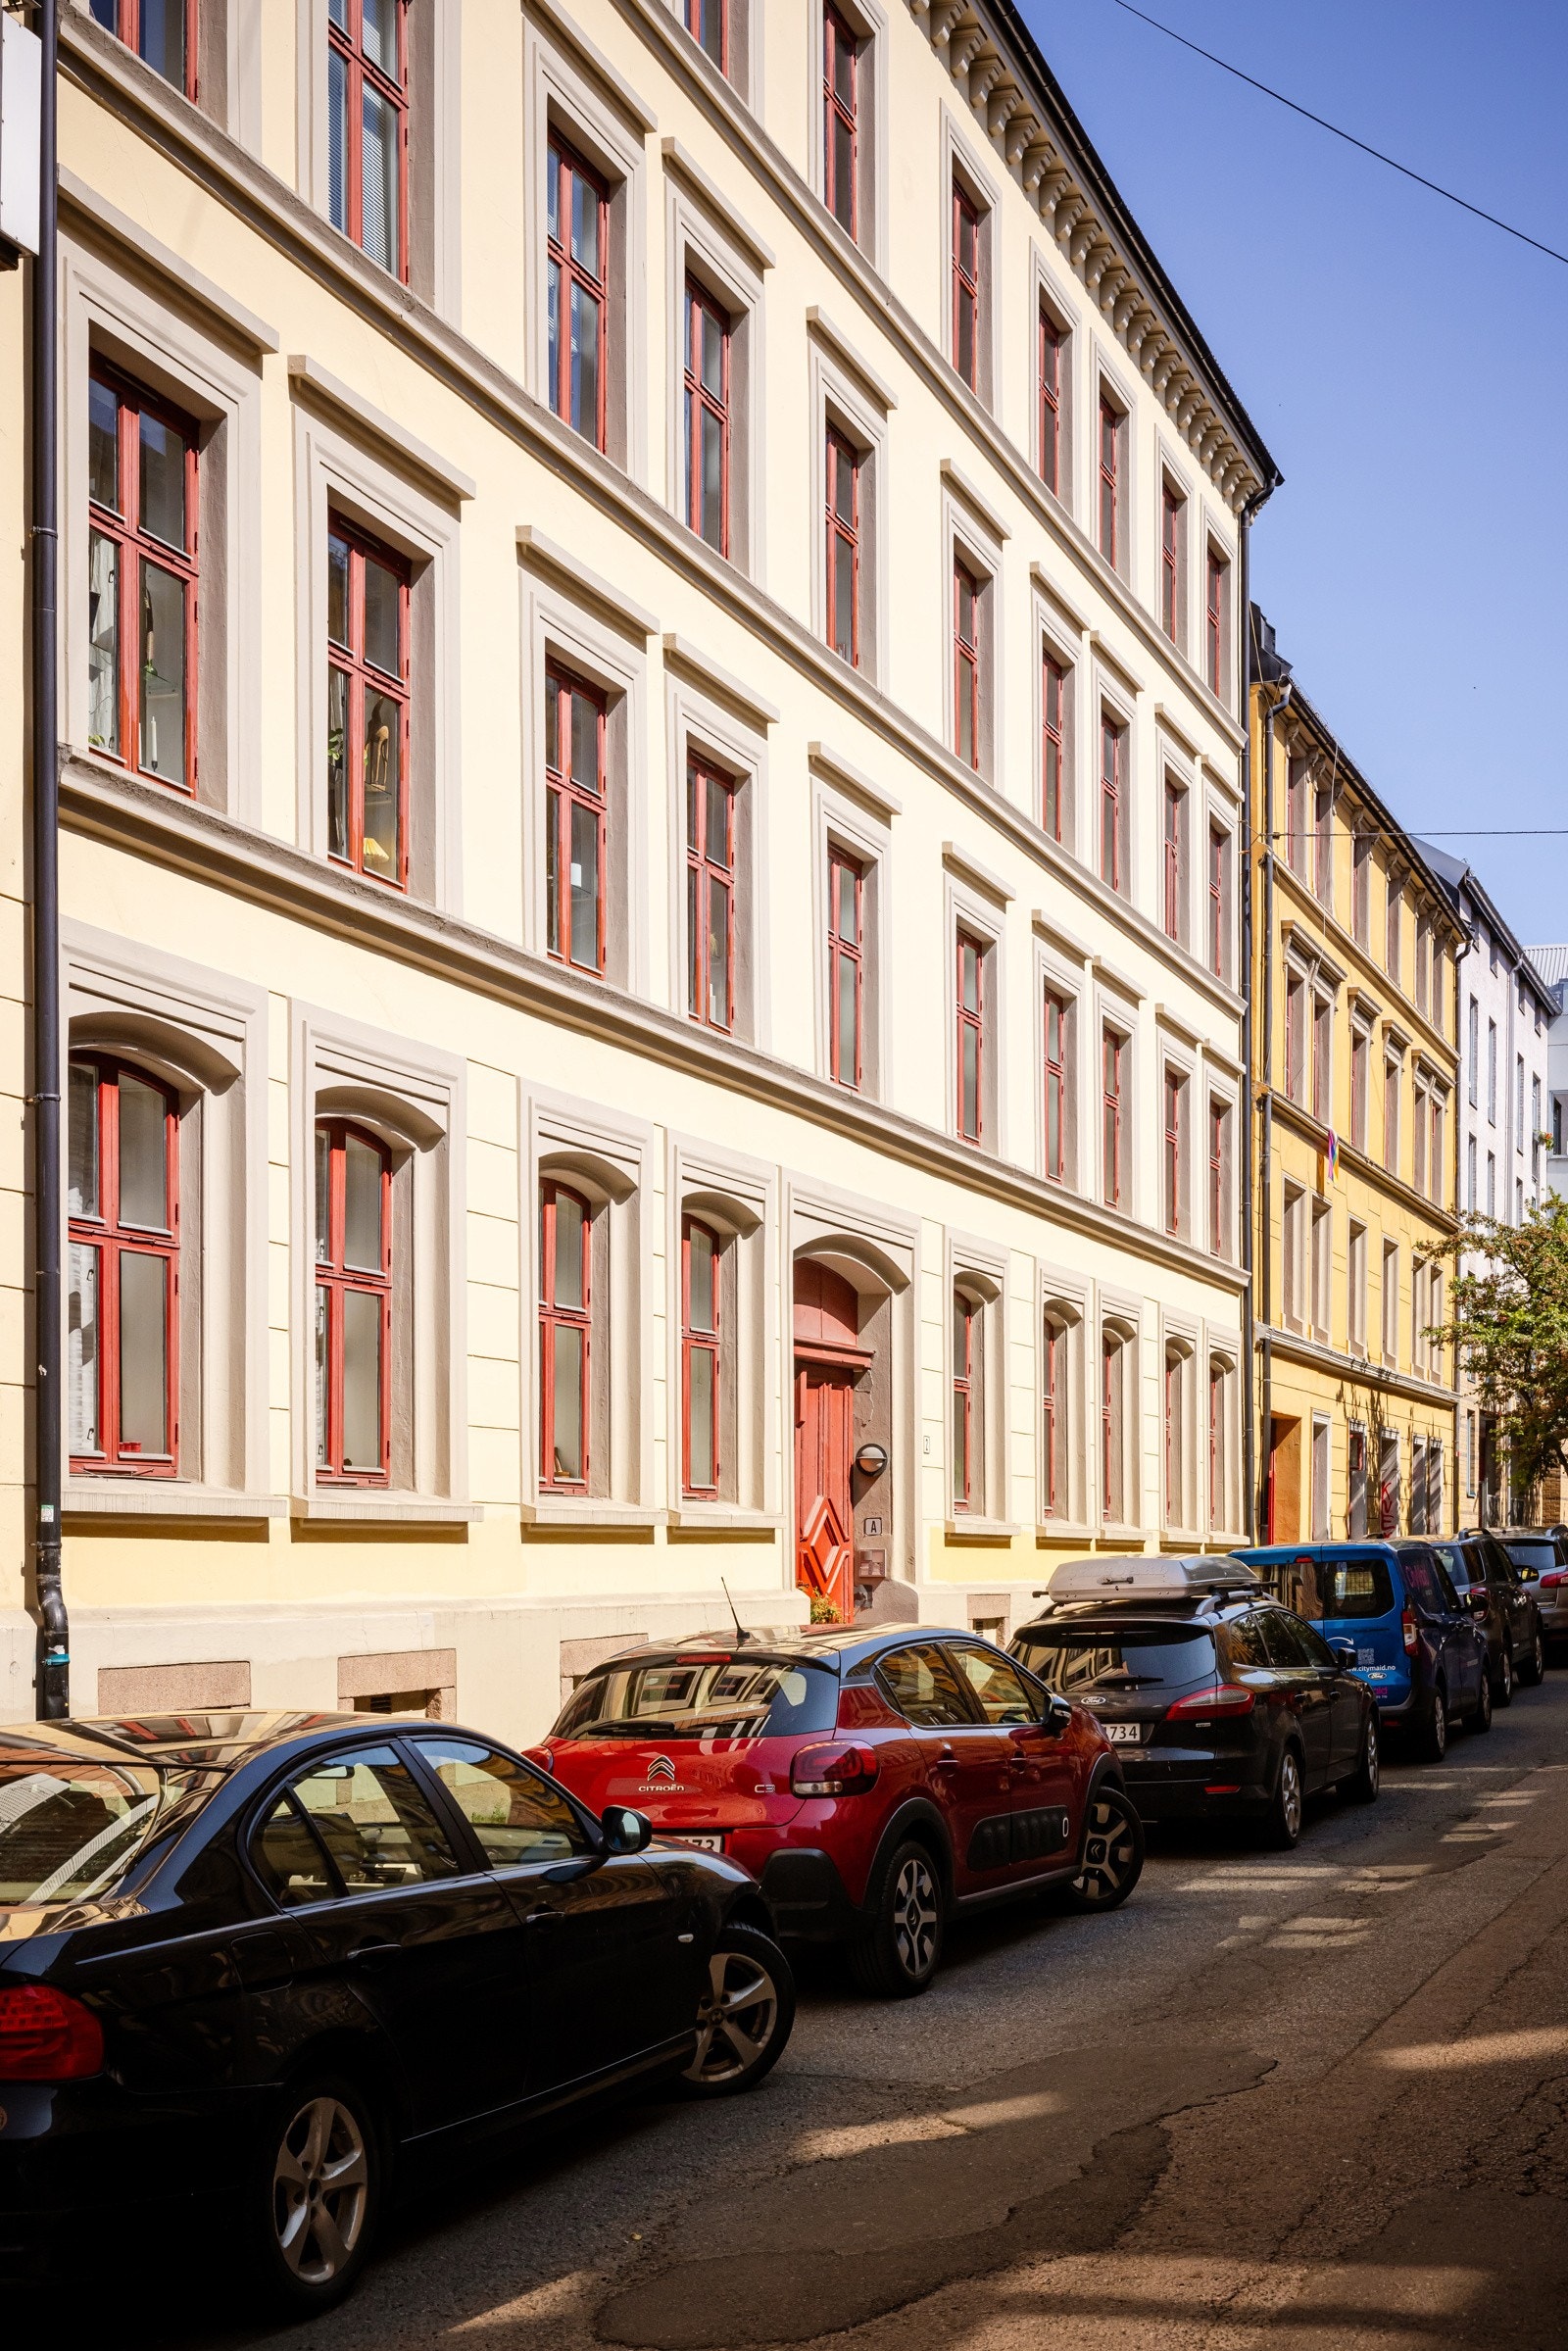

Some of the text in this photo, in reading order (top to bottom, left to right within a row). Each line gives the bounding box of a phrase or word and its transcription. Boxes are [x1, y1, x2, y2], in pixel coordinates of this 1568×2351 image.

[870, 1520, 877, 1534] A
[1104, 1726, 1137, 1739] 734
[638, 1784, 685, 1792] CITROËN
[754, 1784, 776, 1793] C3
